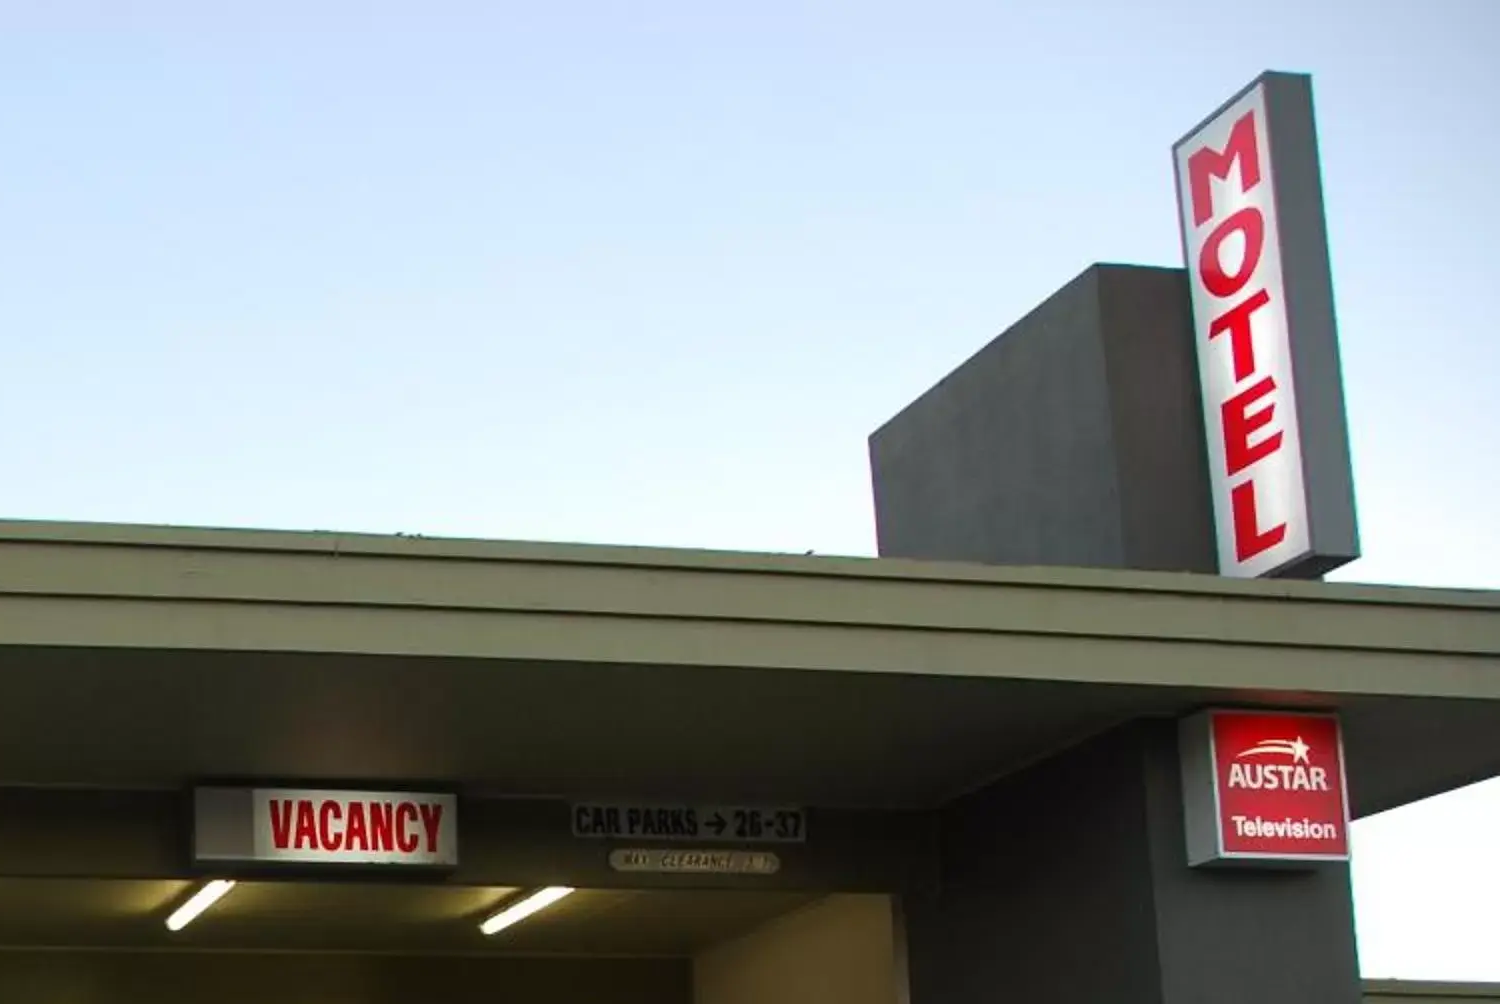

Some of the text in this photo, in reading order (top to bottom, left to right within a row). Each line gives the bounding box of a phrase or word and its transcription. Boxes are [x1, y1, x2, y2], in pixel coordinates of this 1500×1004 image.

[1188, 108, 1287, 563] MOTEL
[1228, 763, 1331, 792] AUSTAR
[269, 799, 443, 853] VACANCY
[576, 806, 622, 835] CAR
[627, 807, 699, 836] PARKS
[1231, 816, 1337, 839] Television
